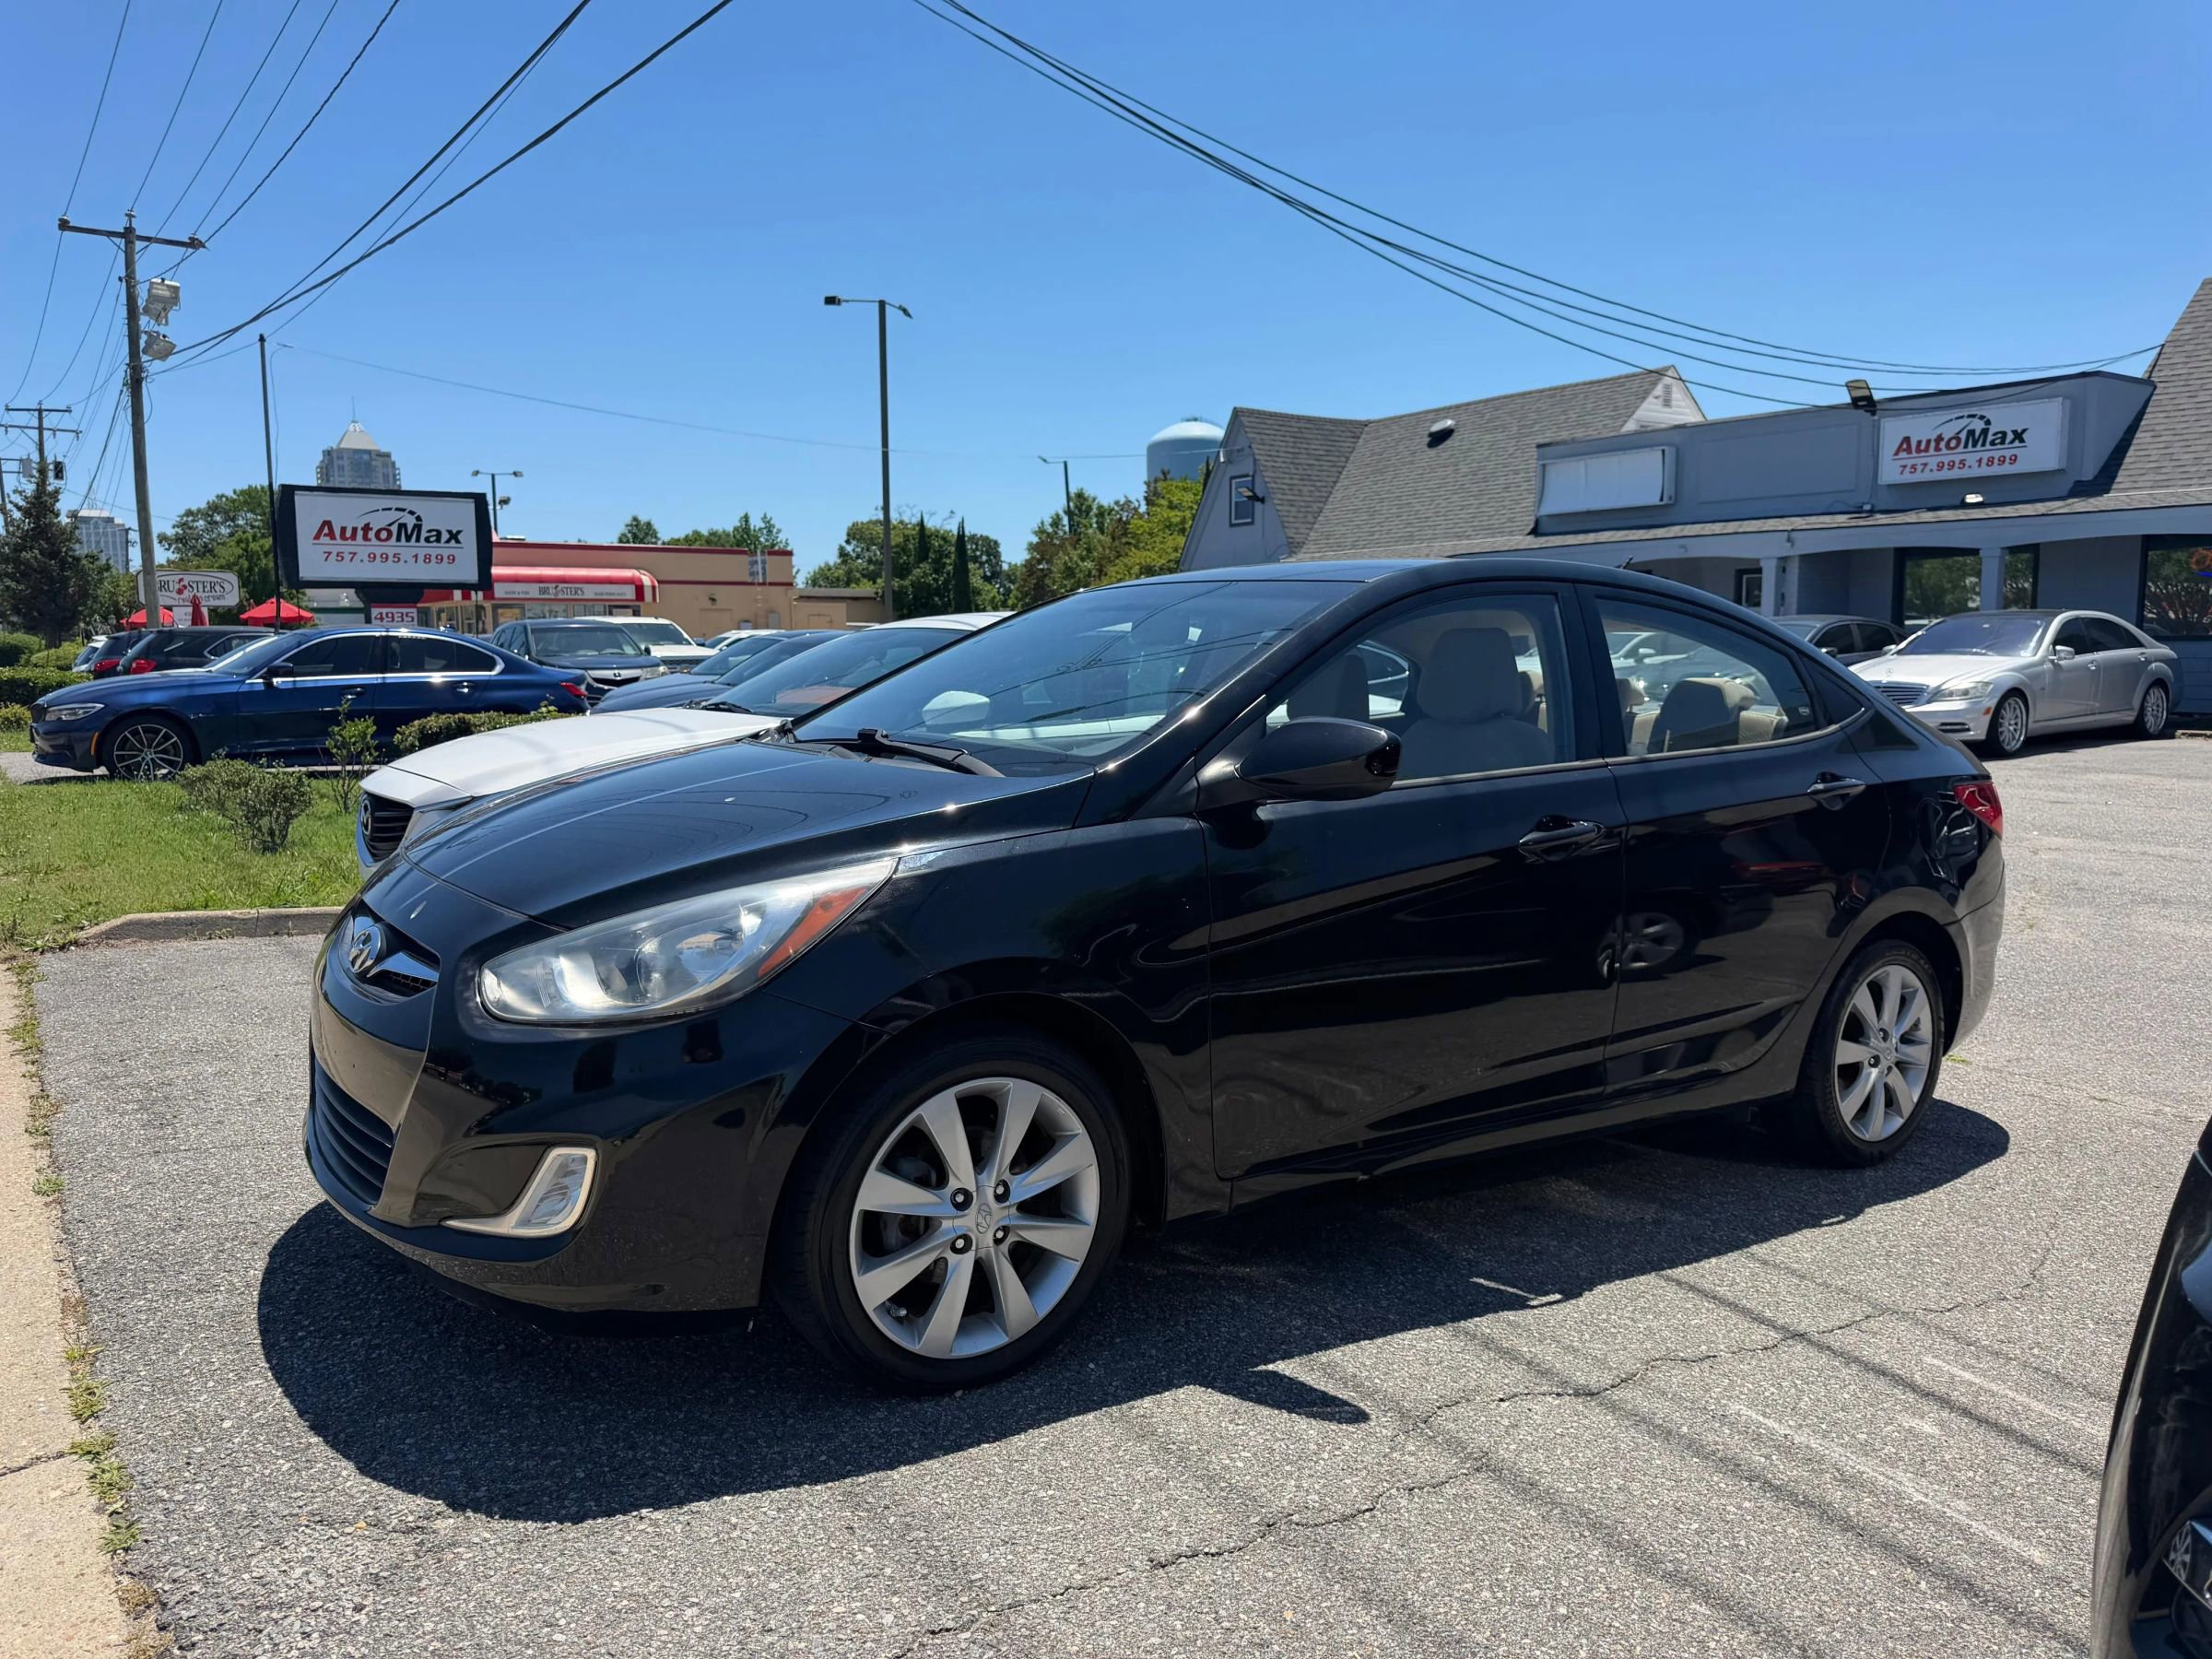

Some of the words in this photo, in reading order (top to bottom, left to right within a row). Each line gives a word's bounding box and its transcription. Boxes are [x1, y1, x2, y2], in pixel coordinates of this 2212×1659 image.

[1892, 428, 2029, 456] AutoMax
[1899, 453, 2018, 475] 757.995.1899
[312, 520, 464, 545] AutoMax
[323, 551, 456, 565] 757.995.1899
[374, 611, 415, 623] 4935
